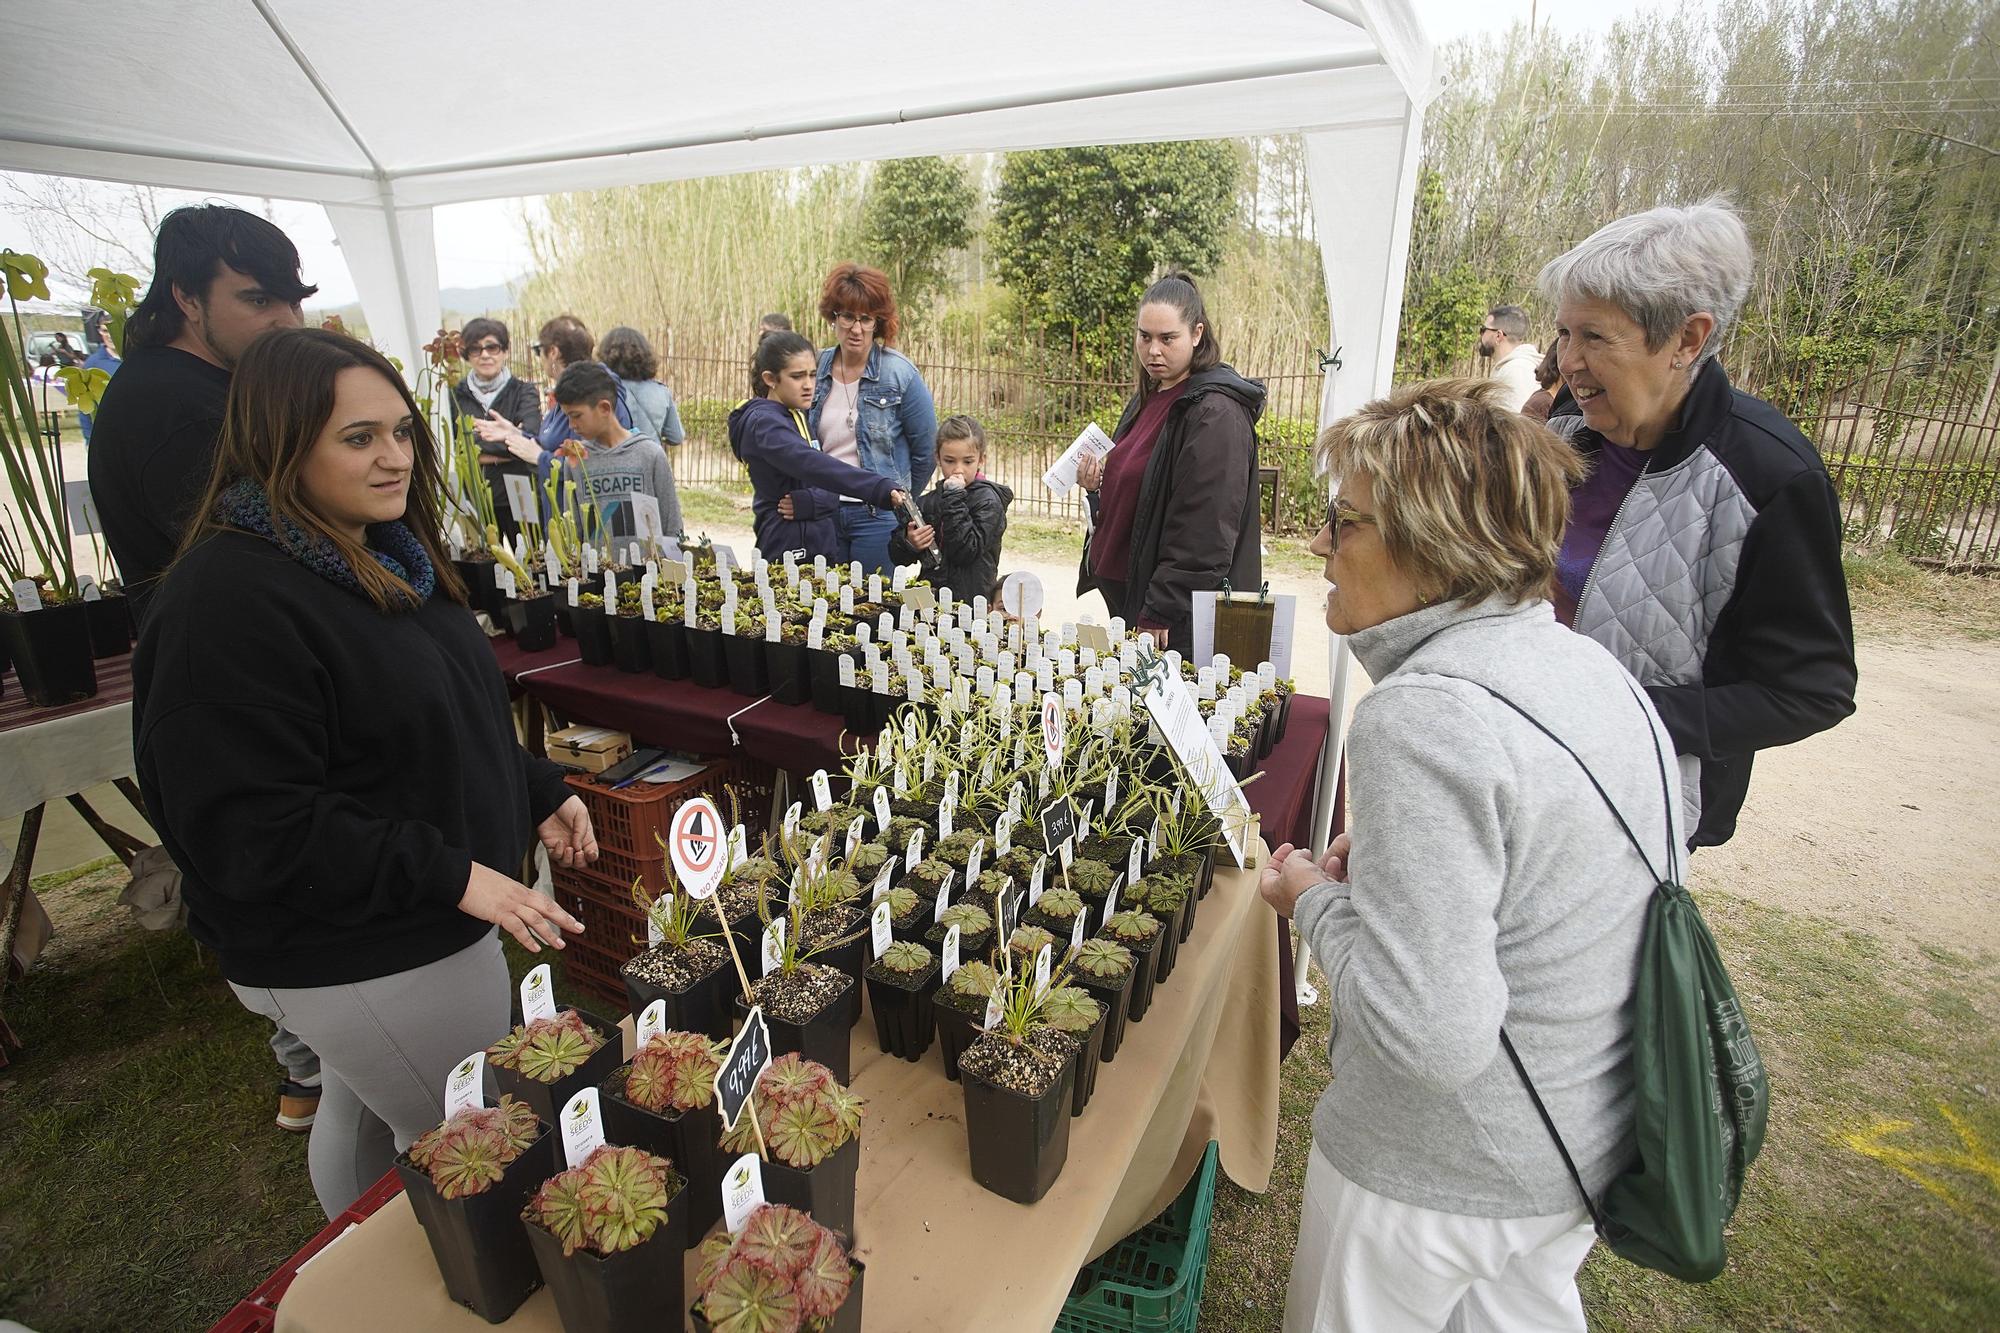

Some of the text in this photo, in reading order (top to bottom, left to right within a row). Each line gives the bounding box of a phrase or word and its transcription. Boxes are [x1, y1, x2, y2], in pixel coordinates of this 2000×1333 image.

[584, 476, 642, 495] ESCAPE
[699, 882, 712, 897] NO
[527, 988, 546, 1003] SEEDS
[453, 1075, 475, 1092] SEEDS
[569, 1118, 593, 1137] SEEDS
[731, 1189, 754, 1209] SEEDS
